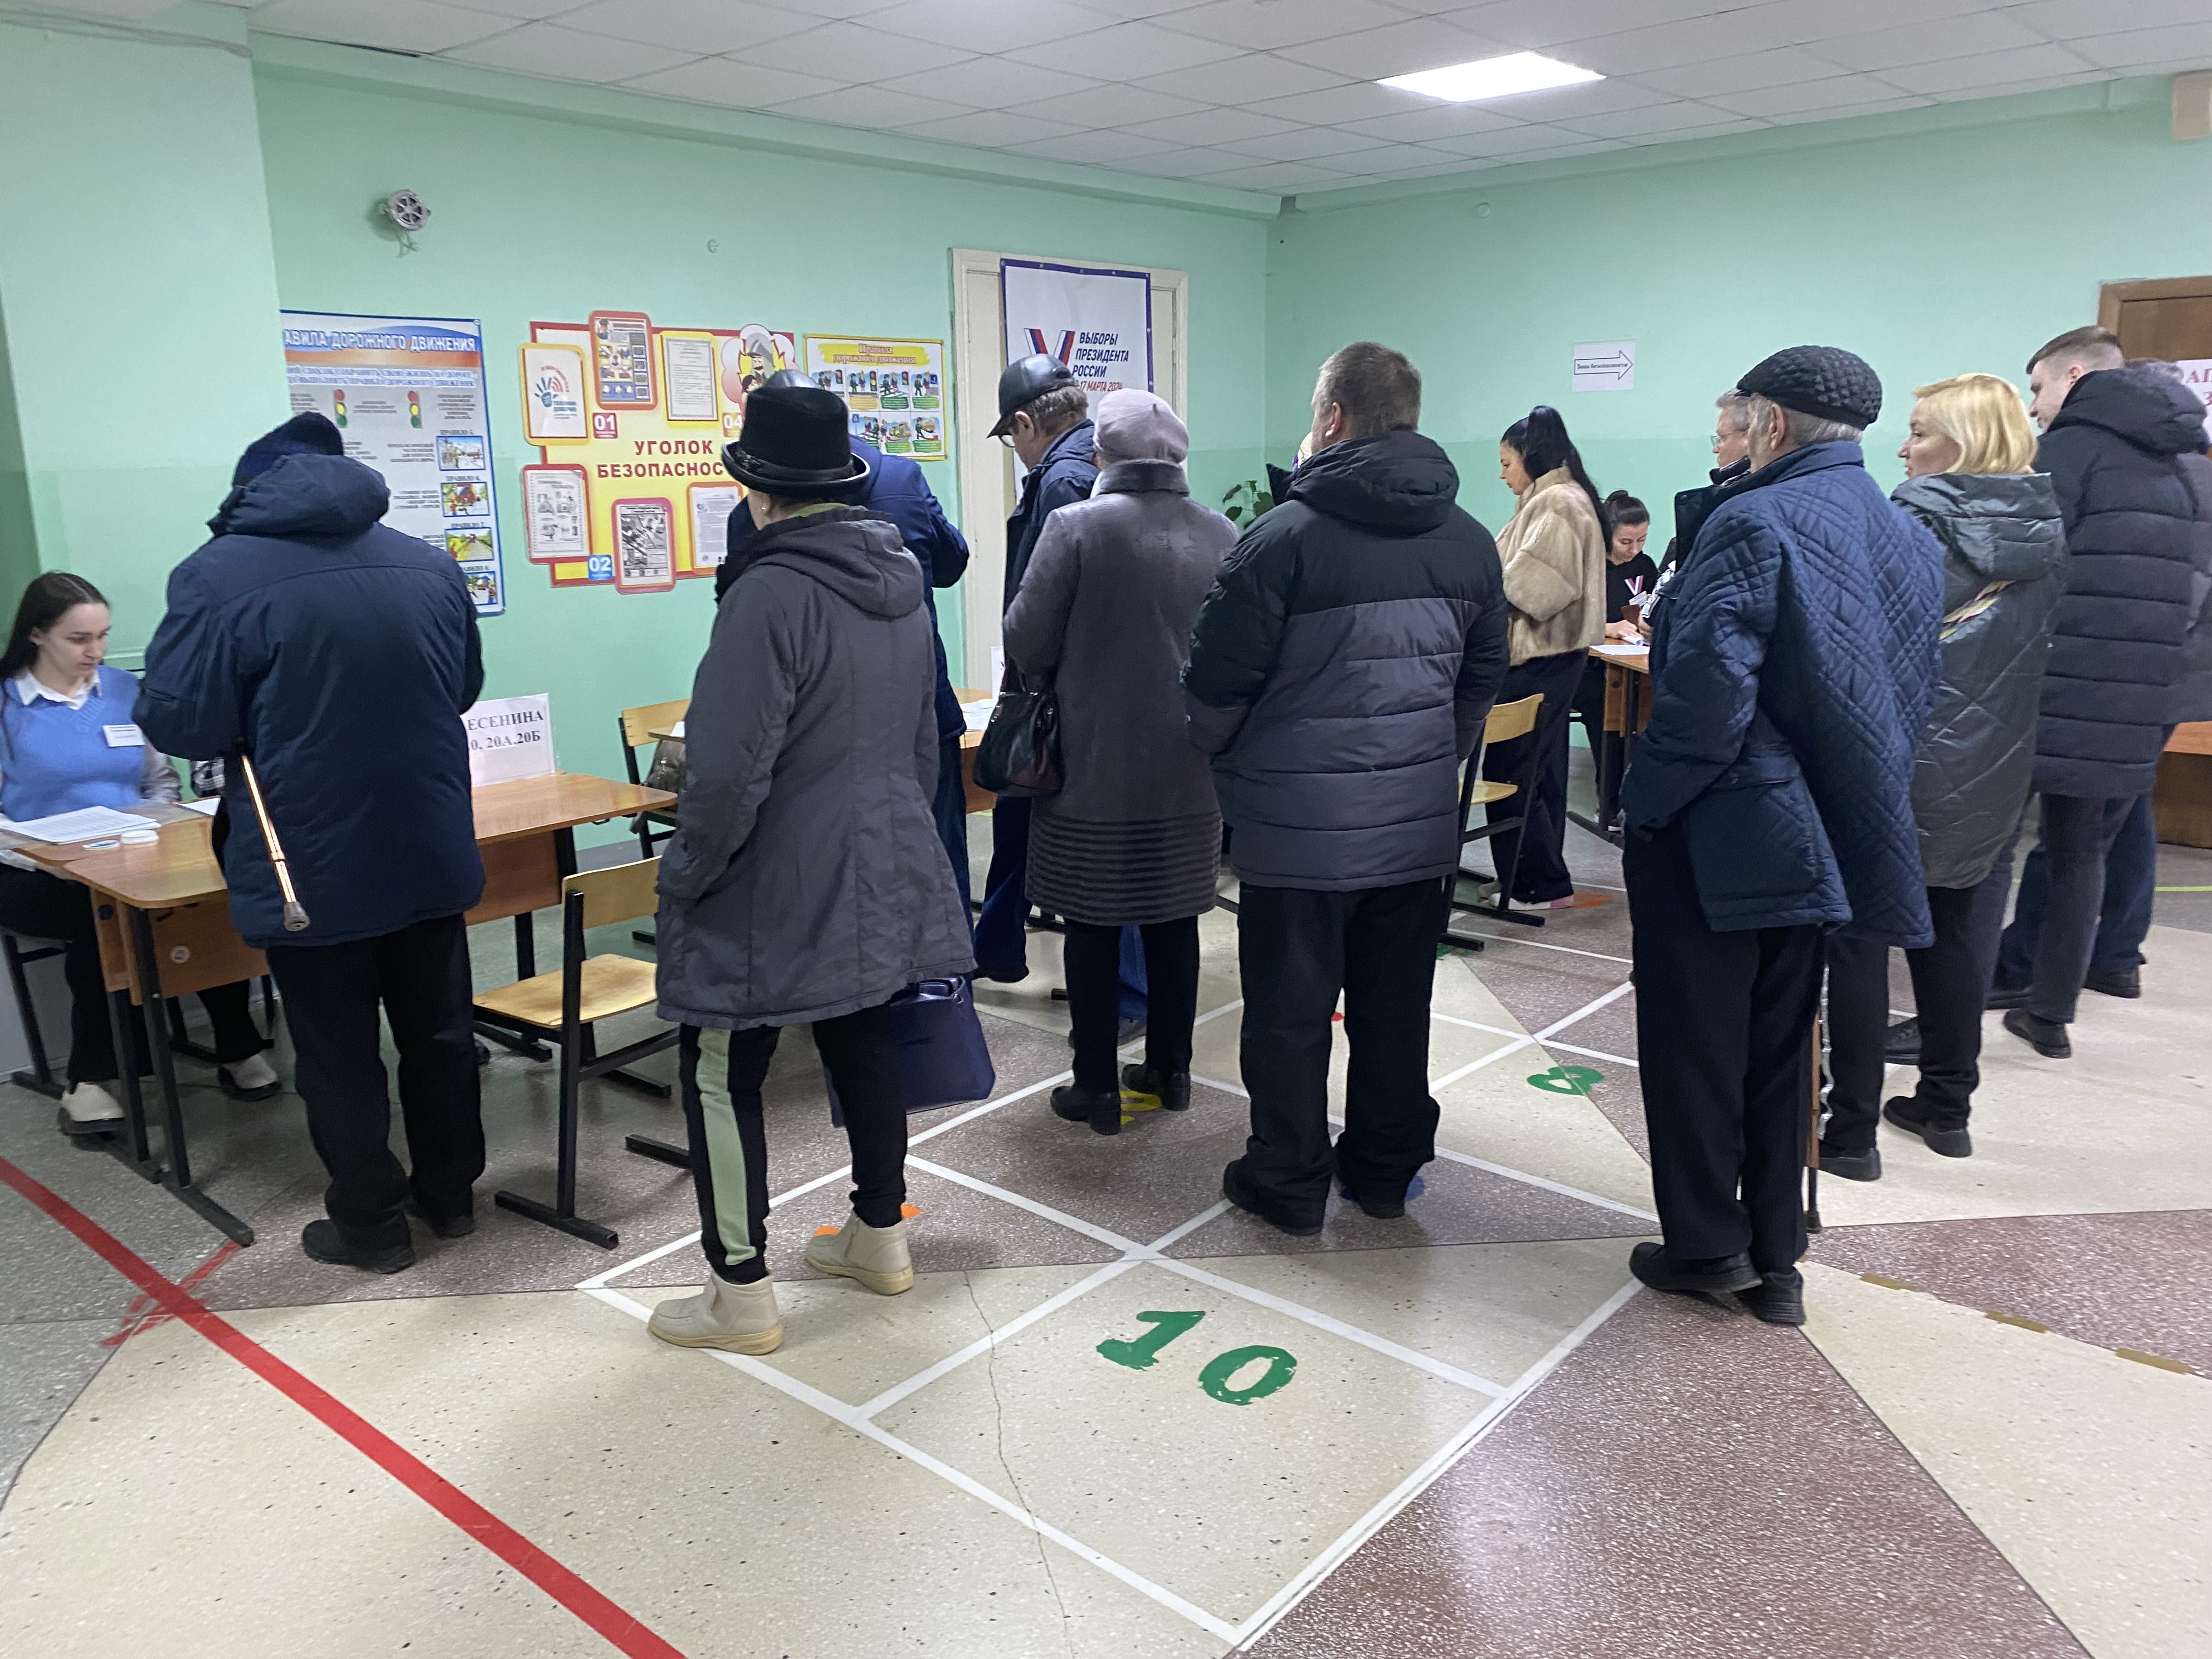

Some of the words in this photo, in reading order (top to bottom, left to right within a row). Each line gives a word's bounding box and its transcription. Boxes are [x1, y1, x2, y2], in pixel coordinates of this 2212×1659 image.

[330, 331, 406, 351] ДОРОЖНОГО
[410, 335, 476, 353] ДВИЖЕНИЯ
[1079, 332, 1118, 345] ВЫБОРЫ
[1075, 348, 1129, 363] ПРЕЗИДЕНТА
[1072, 364, 1107, 377] РОССИИ
[1087, 381, 1107, 391] МАРТА
[594, 415, 615, 431] 01
[724, 414, 743, 429] 04
[634, 440, 713, 455] УГОЛОК
[597, 462, 724, 478] БЕЗОПАСНОС
[589, 556, 611, 572] 02
[467, 710, 544, 730] ЕСЕНИНА
[1096, 1310, 1297, 1406] 10
